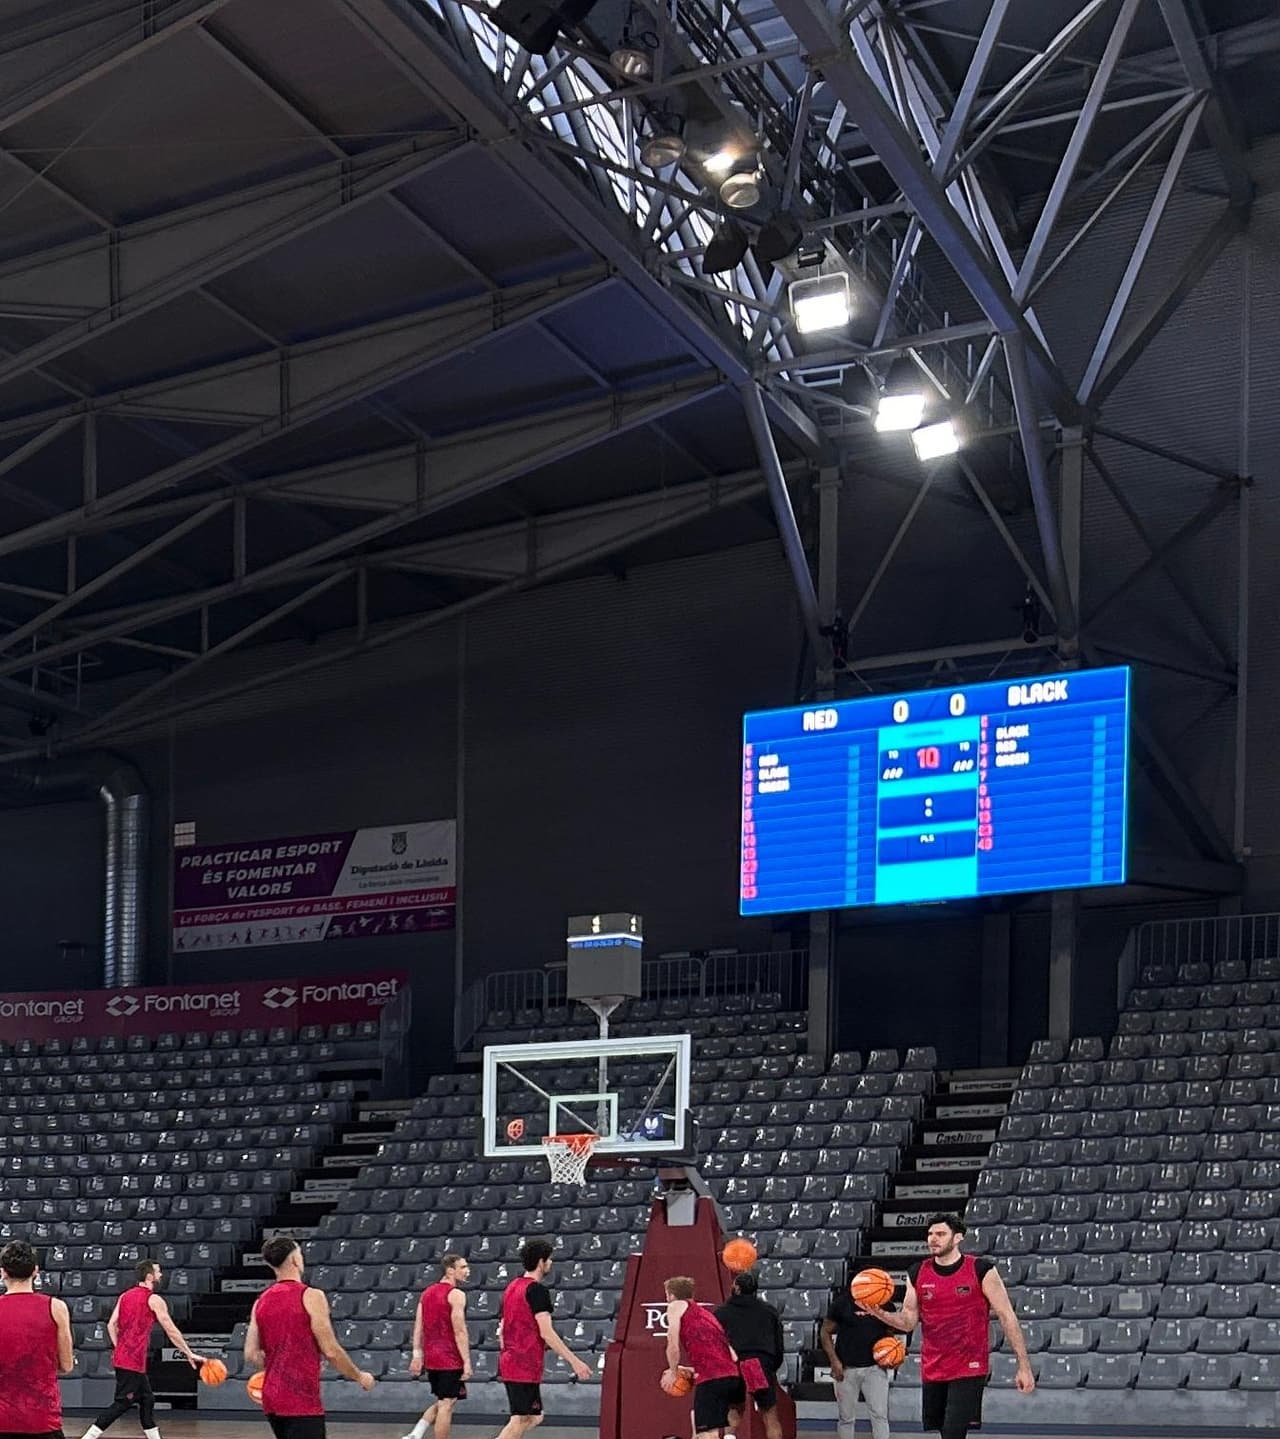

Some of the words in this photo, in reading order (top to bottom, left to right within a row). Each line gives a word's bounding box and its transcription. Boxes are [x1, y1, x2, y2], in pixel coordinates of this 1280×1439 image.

[803, 709, 838, 731] RED
[893, 700, 909, 723] 0
[950, 693, 966, 716] 0
[1008, 679, 1068, 706] BLACK
[917, 747, 939, 768] 10
[180, 848, 272, 868] PRACTICAR
[275, 840, 343, 859] ESPORT
[225, 862, 318, 883] FOMENTAR
[227, 881, 293, 899] VALORS
[302, 977, 399, 1003] Fontanet
[144, 990, 240, 1012] Fontanet
[896, 1214, 926, 1225] Cash
